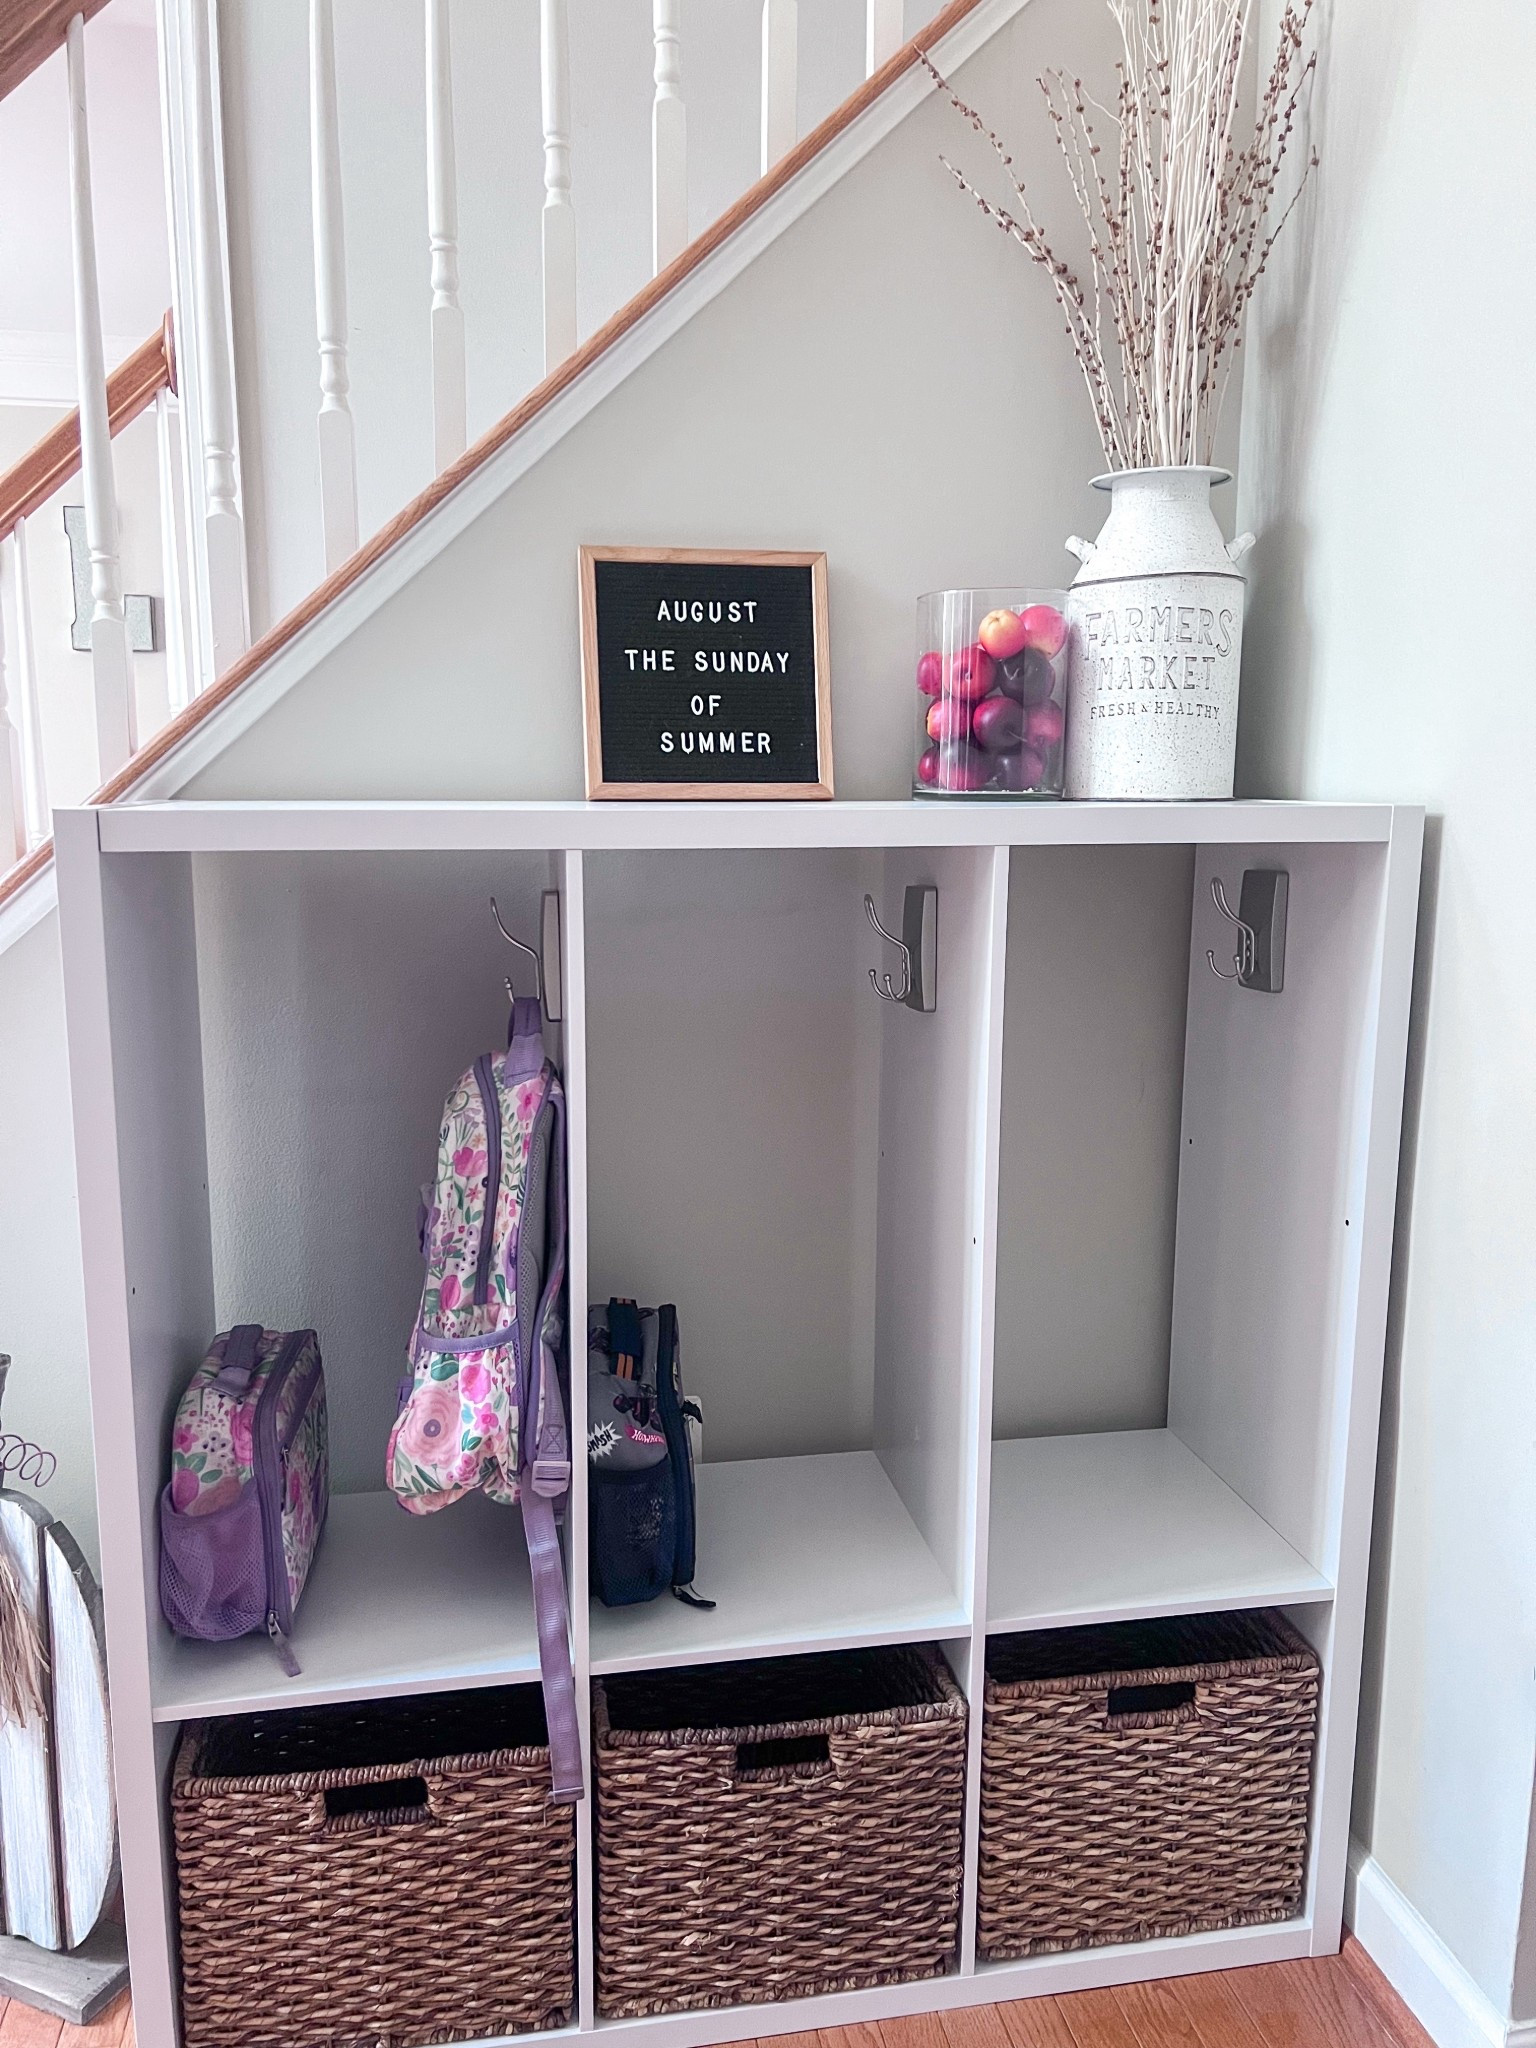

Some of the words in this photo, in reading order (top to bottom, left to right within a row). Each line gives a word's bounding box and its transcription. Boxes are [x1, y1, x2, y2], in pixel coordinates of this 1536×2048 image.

[658, 600, 757, 623] AUGUST
[1084, 605, 1232, 660] FARMERS
[625, 650, 675, 671] THE
[695, 651, 788, 673] SUNDAY
[1098, 656, 1216, 690] MARKET
[691, 695, 721, 716] OF
[1090, 702, 1136, 719] FRESH
[1154, 701, 1220, 719] HEALTHY
[661, 732, 770, 754] SUMMER
